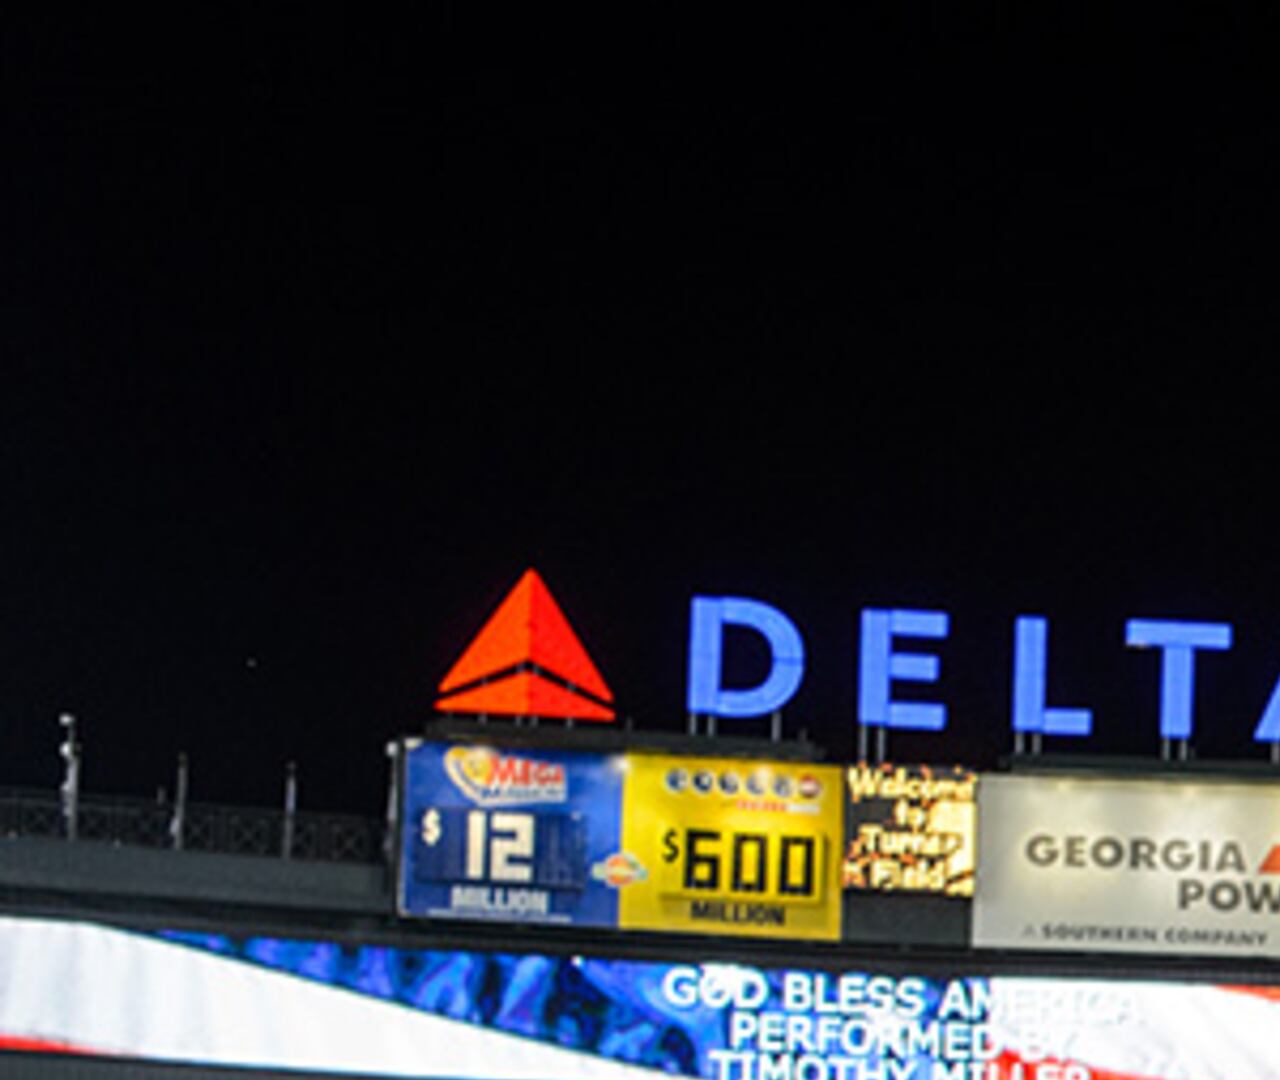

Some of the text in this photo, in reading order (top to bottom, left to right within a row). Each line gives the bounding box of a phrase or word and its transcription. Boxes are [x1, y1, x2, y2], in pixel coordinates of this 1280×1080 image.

[421, 808, 535, 882] $ 12
[661, 827, 816, 898] $ 600
[1025, 834, 1247, 874] GEORGIA
[450, 884, 549, 916] MILLION
[690, 900, 787, 927] MILLION
[1040, 923, 1158, 945] SOUTHERN
[1164, 928, 1268, 947] COMPANY
[662, 967, 769, 1009] GOD
[783, 973, 928, 1017] BLESS
[729, 1010, 1007, 1061] PERFORMED
